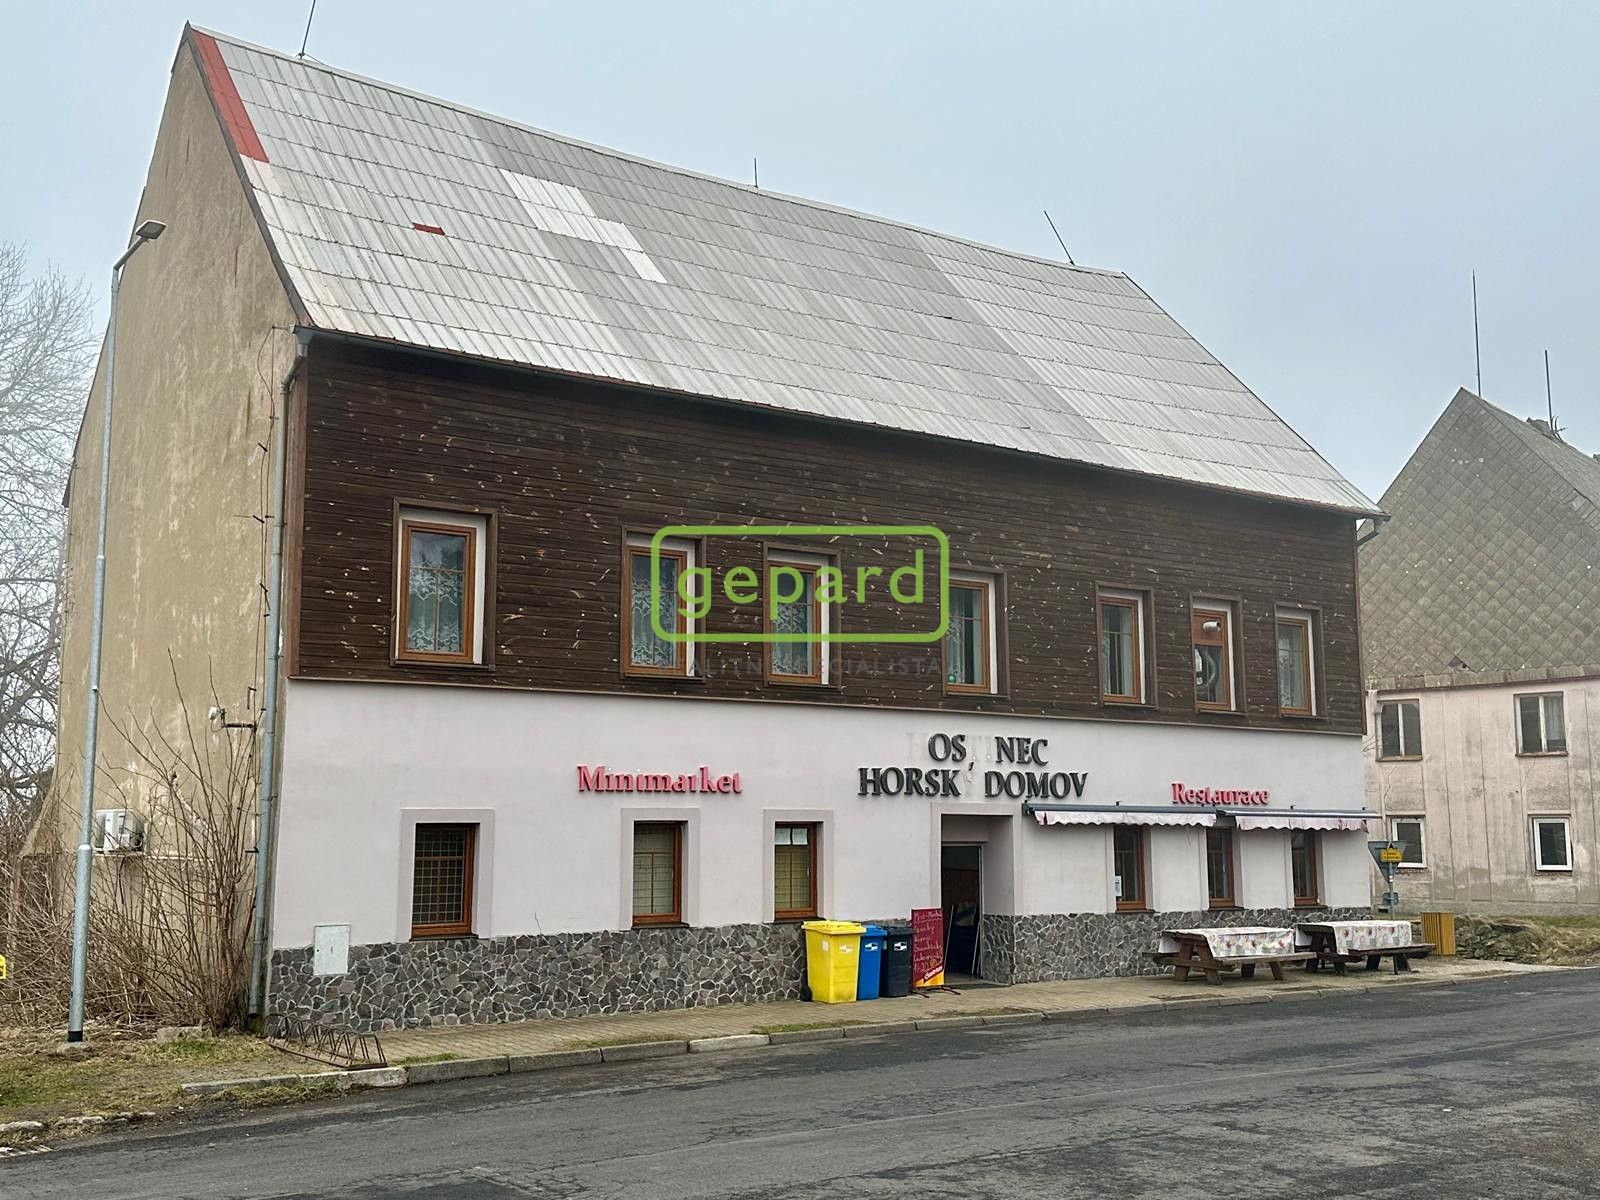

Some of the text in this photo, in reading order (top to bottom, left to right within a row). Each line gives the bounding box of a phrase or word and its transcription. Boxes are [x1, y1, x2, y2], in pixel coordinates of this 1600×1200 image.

[576, 764, 743, 794] Minimarket
[984, 770, 1089, 800] DOMOV
[1170, 782, 1270, 806] Restaurace
